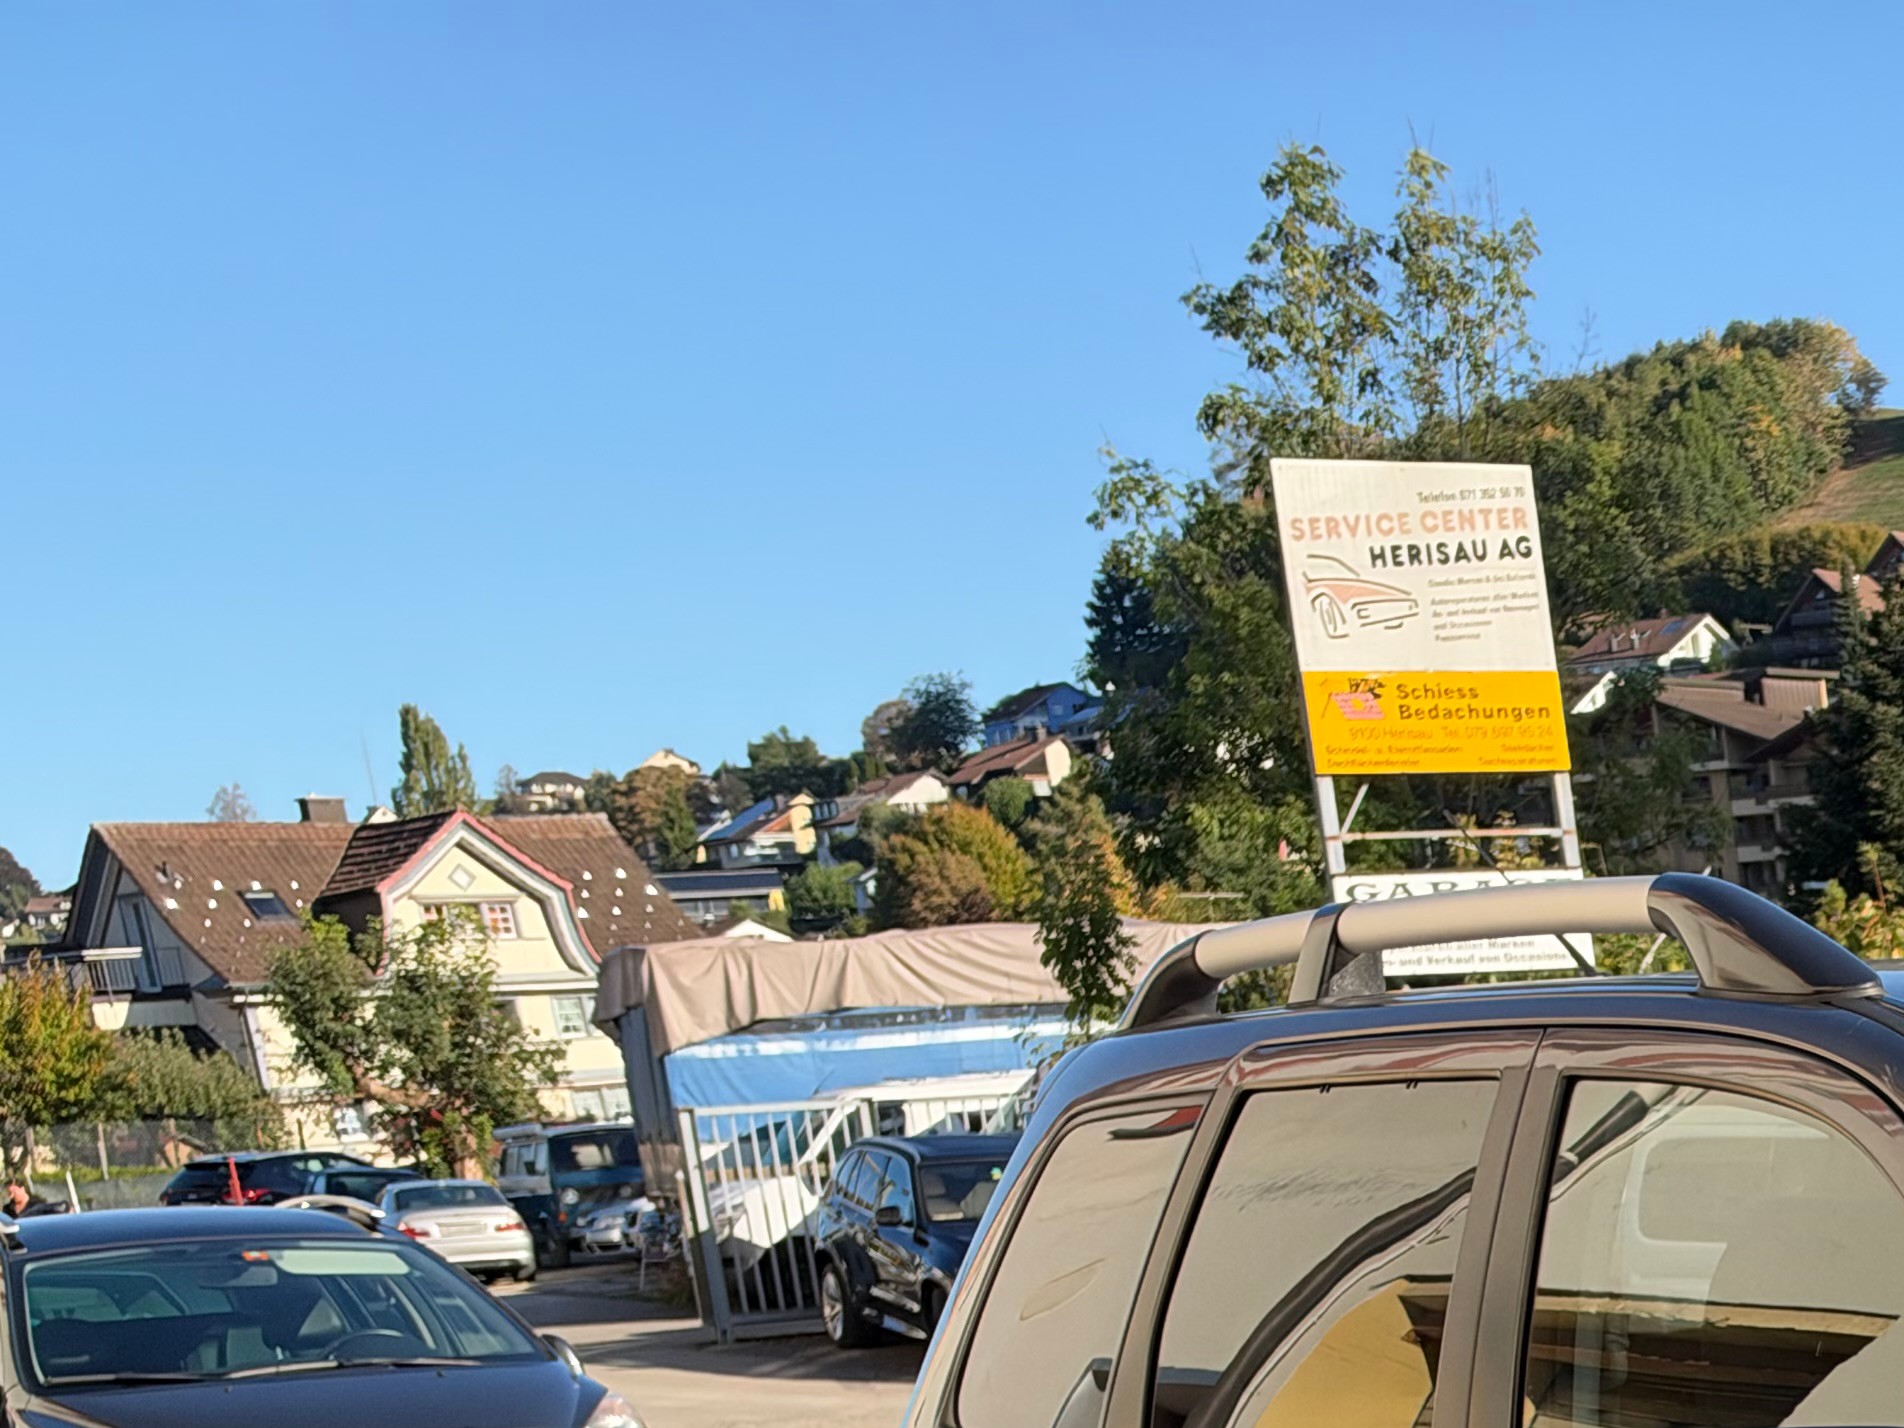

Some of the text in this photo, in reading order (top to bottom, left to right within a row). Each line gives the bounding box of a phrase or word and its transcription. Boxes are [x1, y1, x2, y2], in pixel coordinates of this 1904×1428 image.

[1290, 507, 1529, 542] SERVICE CENTER
[1369, 535, 1534, 569] HERISAU AG
[1396, 683, 1480, 700] Schiess
[1399, 704, 1551, 722] Bedachungen
